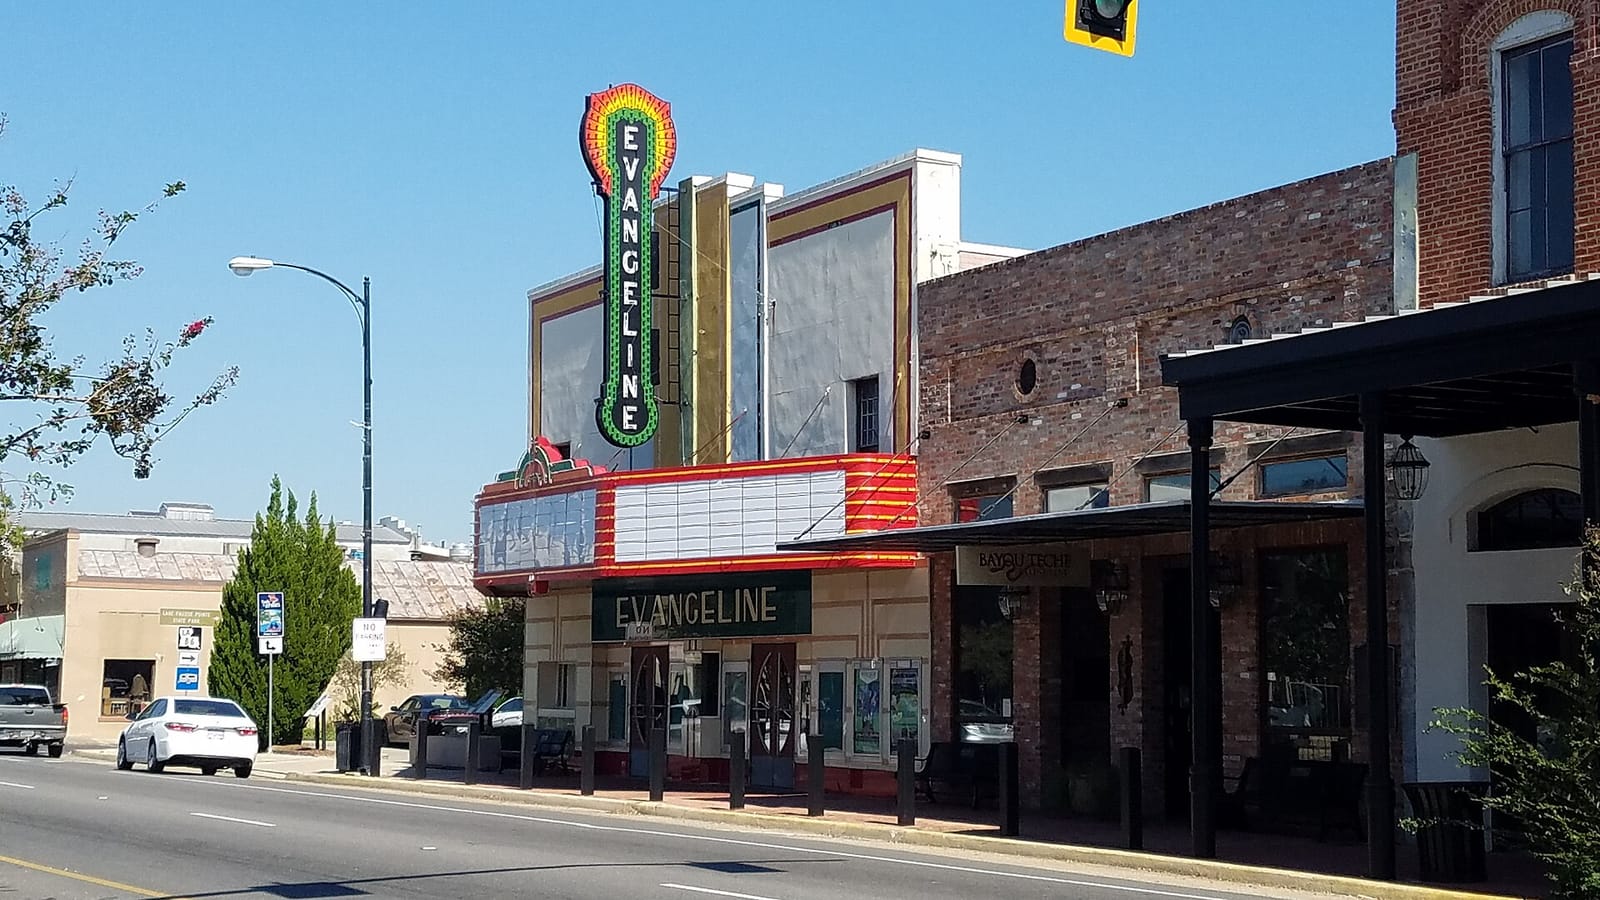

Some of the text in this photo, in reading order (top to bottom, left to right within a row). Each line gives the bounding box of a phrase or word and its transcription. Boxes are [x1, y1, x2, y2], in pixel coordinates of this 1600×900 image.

[622, 125, 640, 430] EVANGELINE
[979, 552, 1024, 573] BAYOU
[616, 586, 777, 629] EVANGELINE
[363, 623, 376, 631] NO
